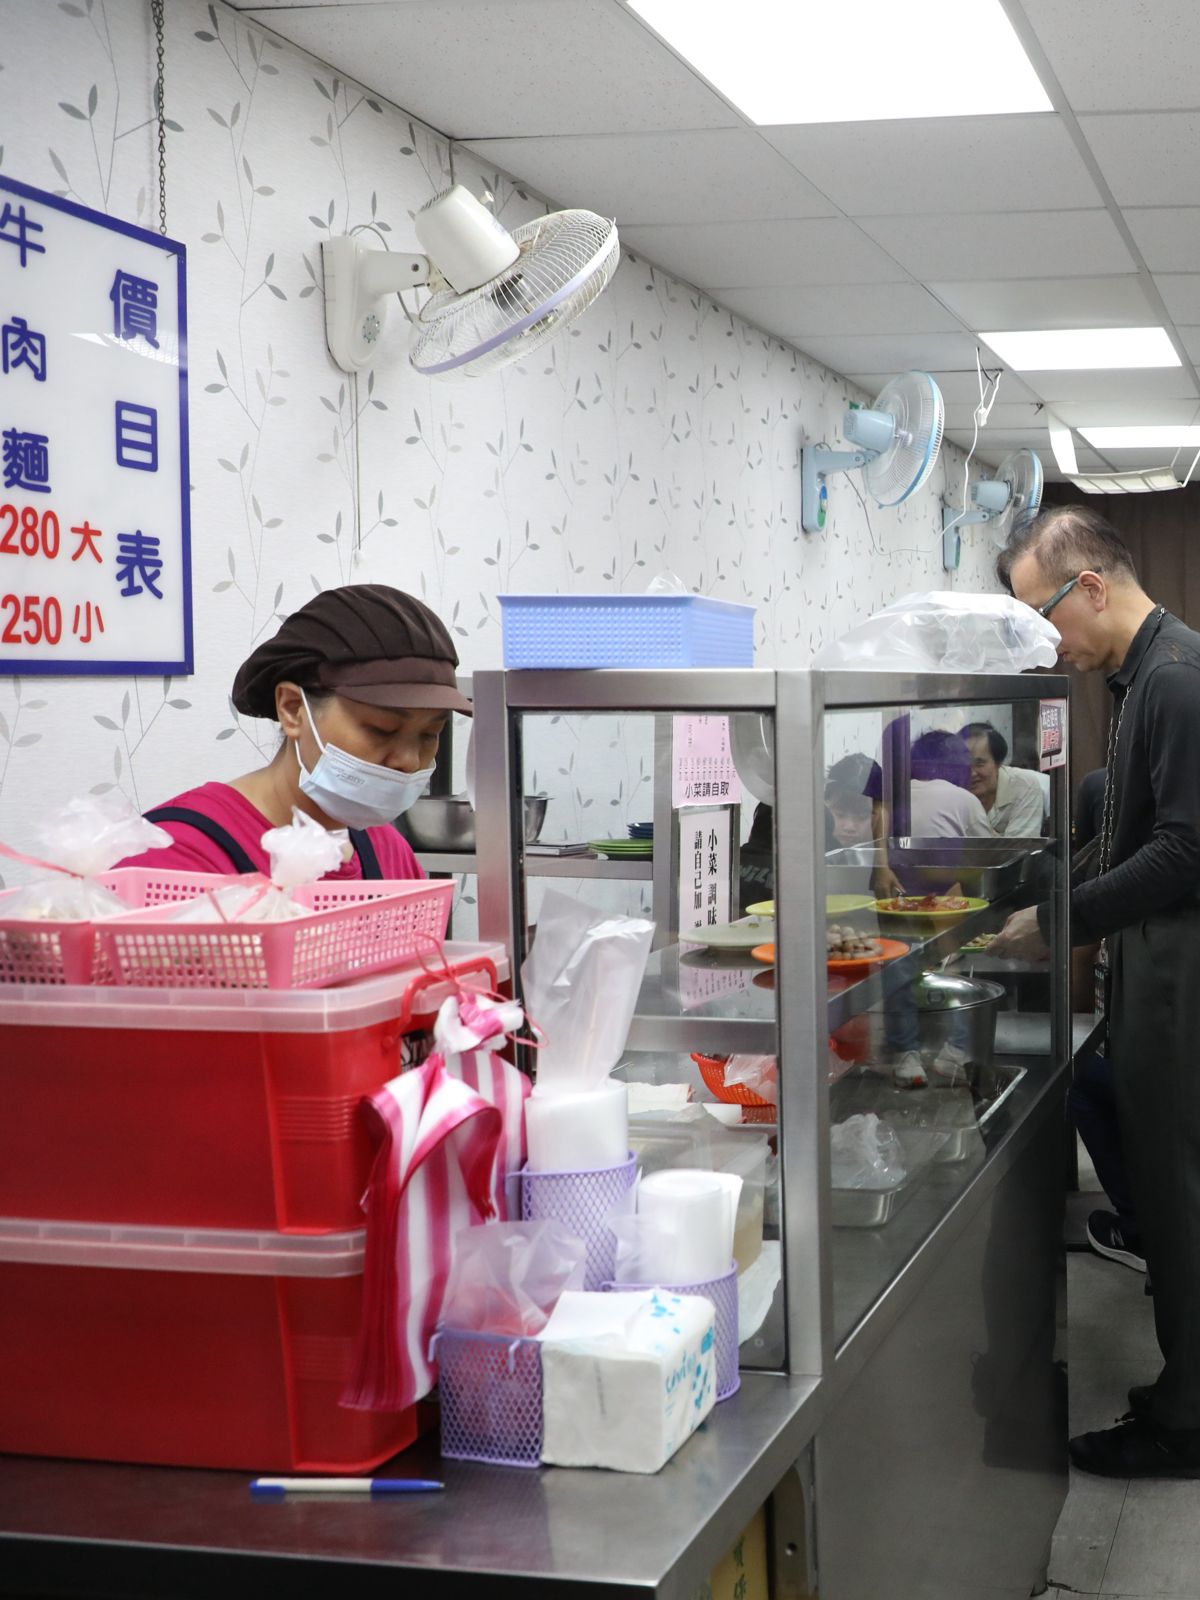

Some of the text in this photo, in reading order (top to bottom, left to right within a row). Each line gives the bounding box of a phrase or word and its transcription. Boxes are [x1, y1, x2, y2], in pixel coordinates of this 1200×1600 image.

[0, 204, 52, 494] 牛肉麵
[110, 268, 164, 600] 價目表
[0, 505, 103, 564] 280 大
[0, 594, 105, 644] 250 小
[685, 781, 730, 799] 小菜請自取
